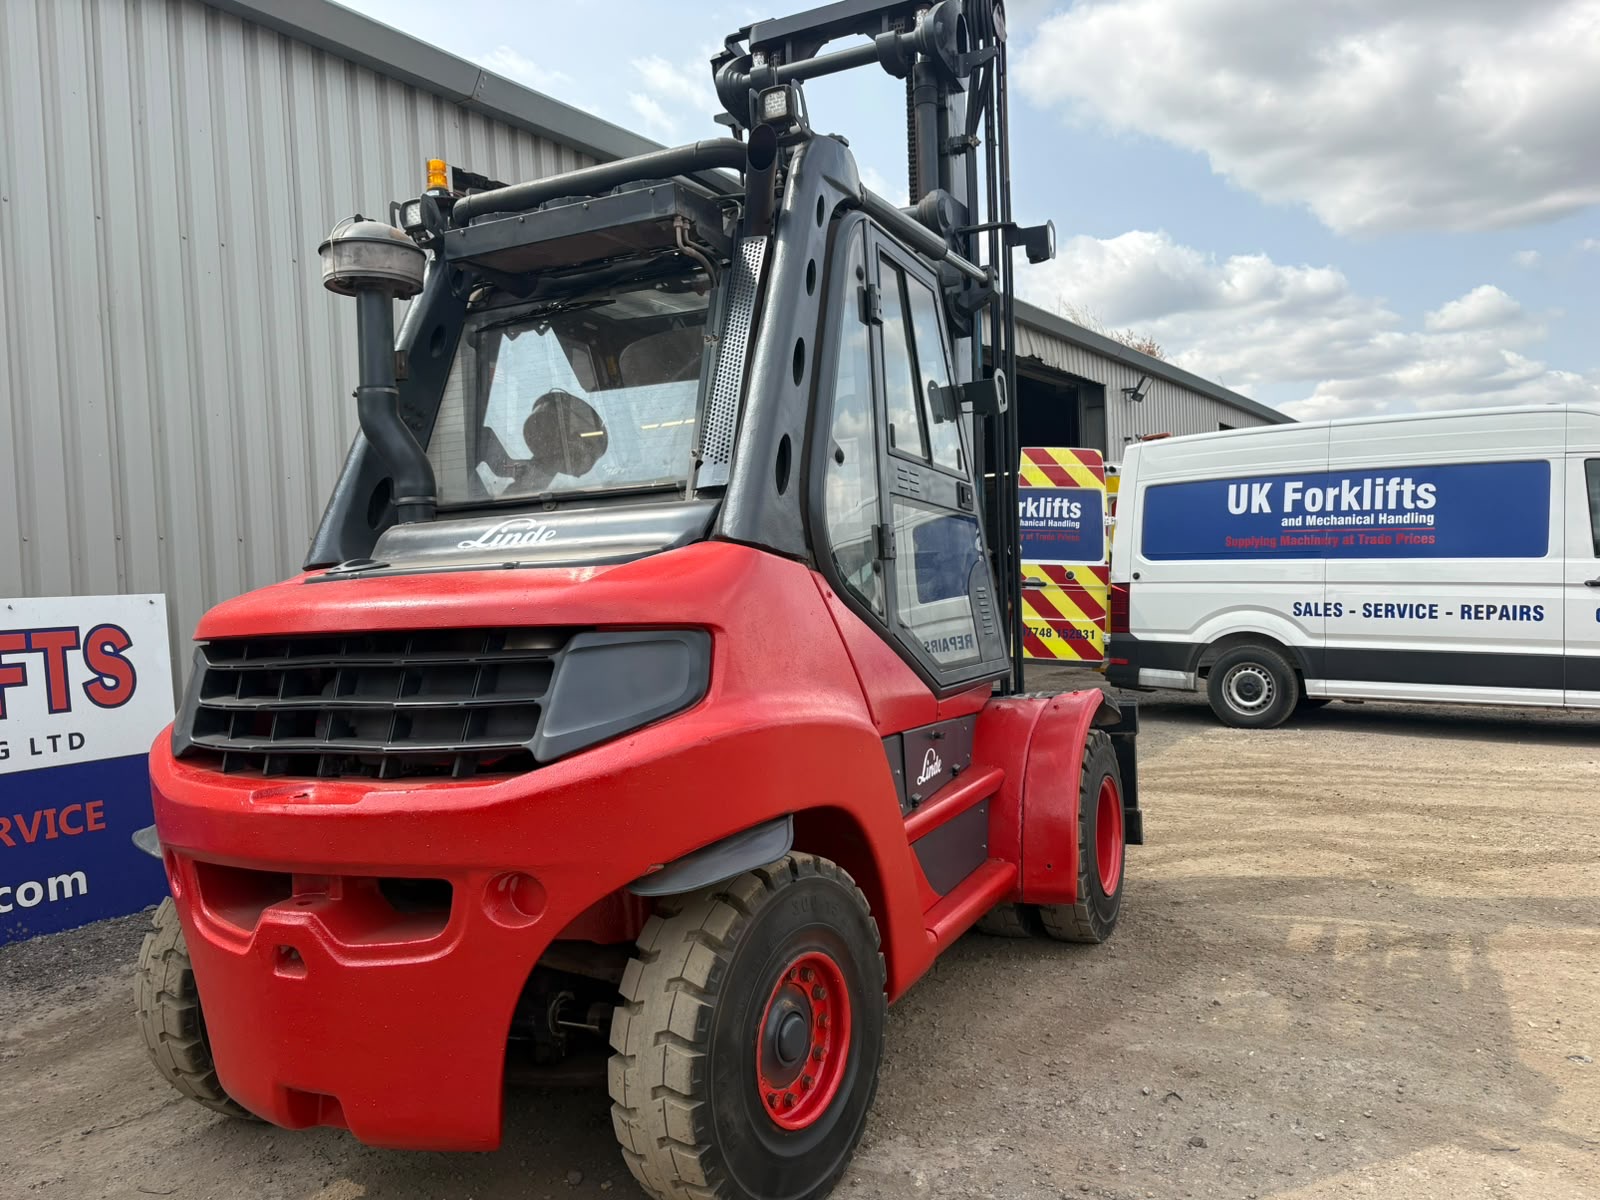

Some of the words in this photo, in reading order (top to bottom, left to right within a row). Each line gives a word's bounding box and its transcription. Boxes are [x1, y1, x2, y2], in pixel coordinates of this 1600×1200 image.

[1227, 482, 1273, 515] UK
[1283, 477, 1437, 512] Forklifts
[1047, 519, 1080, 529] Handling
[1281, 515, 1302, 527] and
[1305, 513, 1374, 526] Mechanical
[1378, 512, 1435, 526] Handling
[457, 518, 557, 549] Linde
[1225, 536, 1277, 548] Supplying
[1280, 535, 1339, 547] Machinery
[1342, 535, 1354, 545] at
[1358, 534, 1392, 545] Trade
[1396, 532, 1436, 545] Prices
[1292, 602, 1343, 618] SALES
[1362, 602, 1439, 620] SERVICE
[1460, 604, 1545, 622] REPAIRS
[30, 732, 86, 756] LTD
[916, 747, 942, 786] Linde
